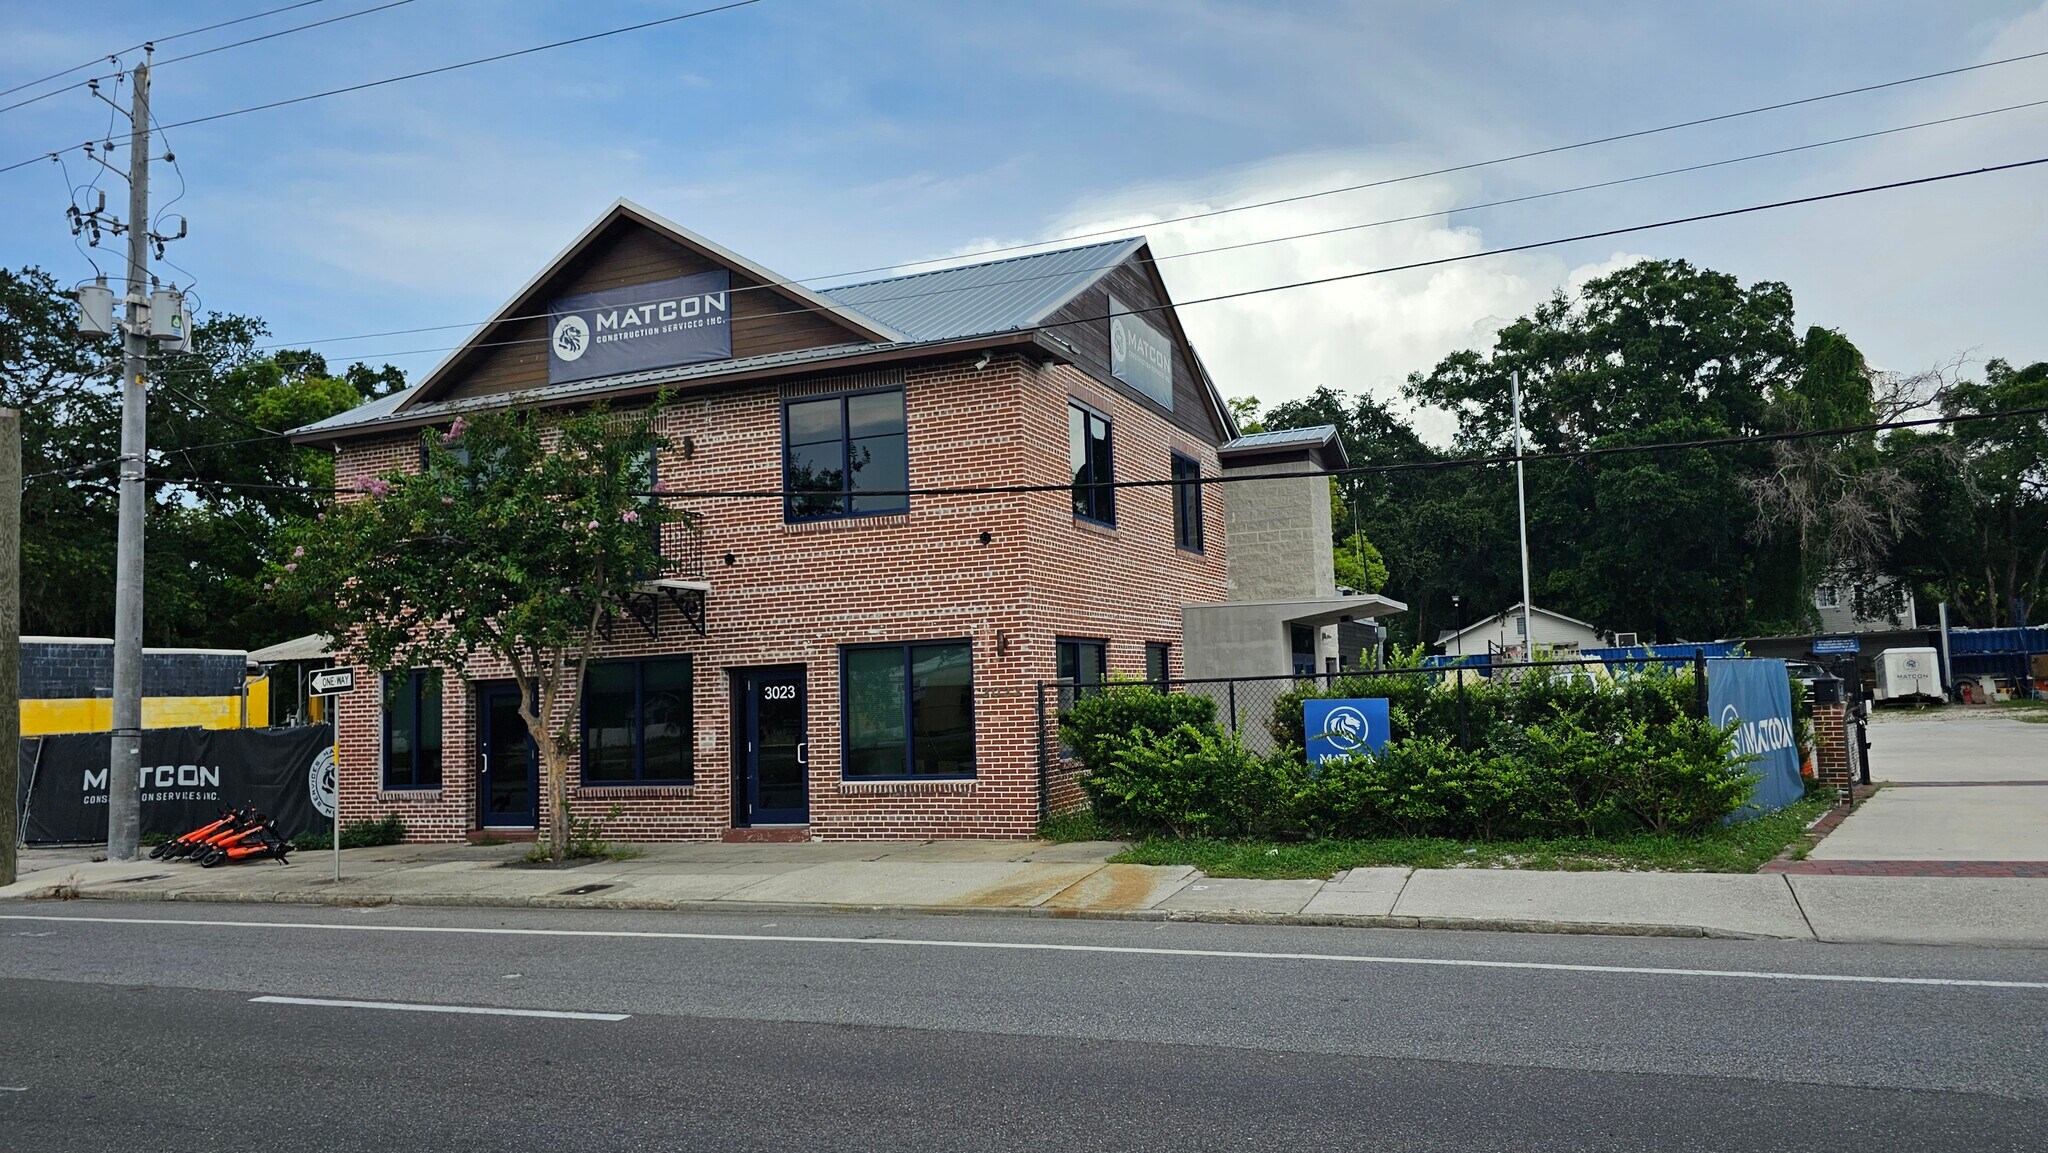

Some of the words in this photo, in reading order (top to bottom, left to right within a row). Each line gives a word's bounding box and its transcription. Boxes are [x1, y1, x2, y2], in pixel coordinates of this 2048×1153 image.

[596, 292, 726, 331] MATCON
[596, 327, 649, 343] CONSTRUCTION
[662, 319, 703, 333] SERVICES
[706, 316, 726, 326] INC.
[1128, 329, 1171, 374] MATCON
[322, 676, 335, 687] ONE
[336, 674, 350, 685] WAY
[764, 685, 796, 700] 3023
[82, 764, 220, 791] MTCON
